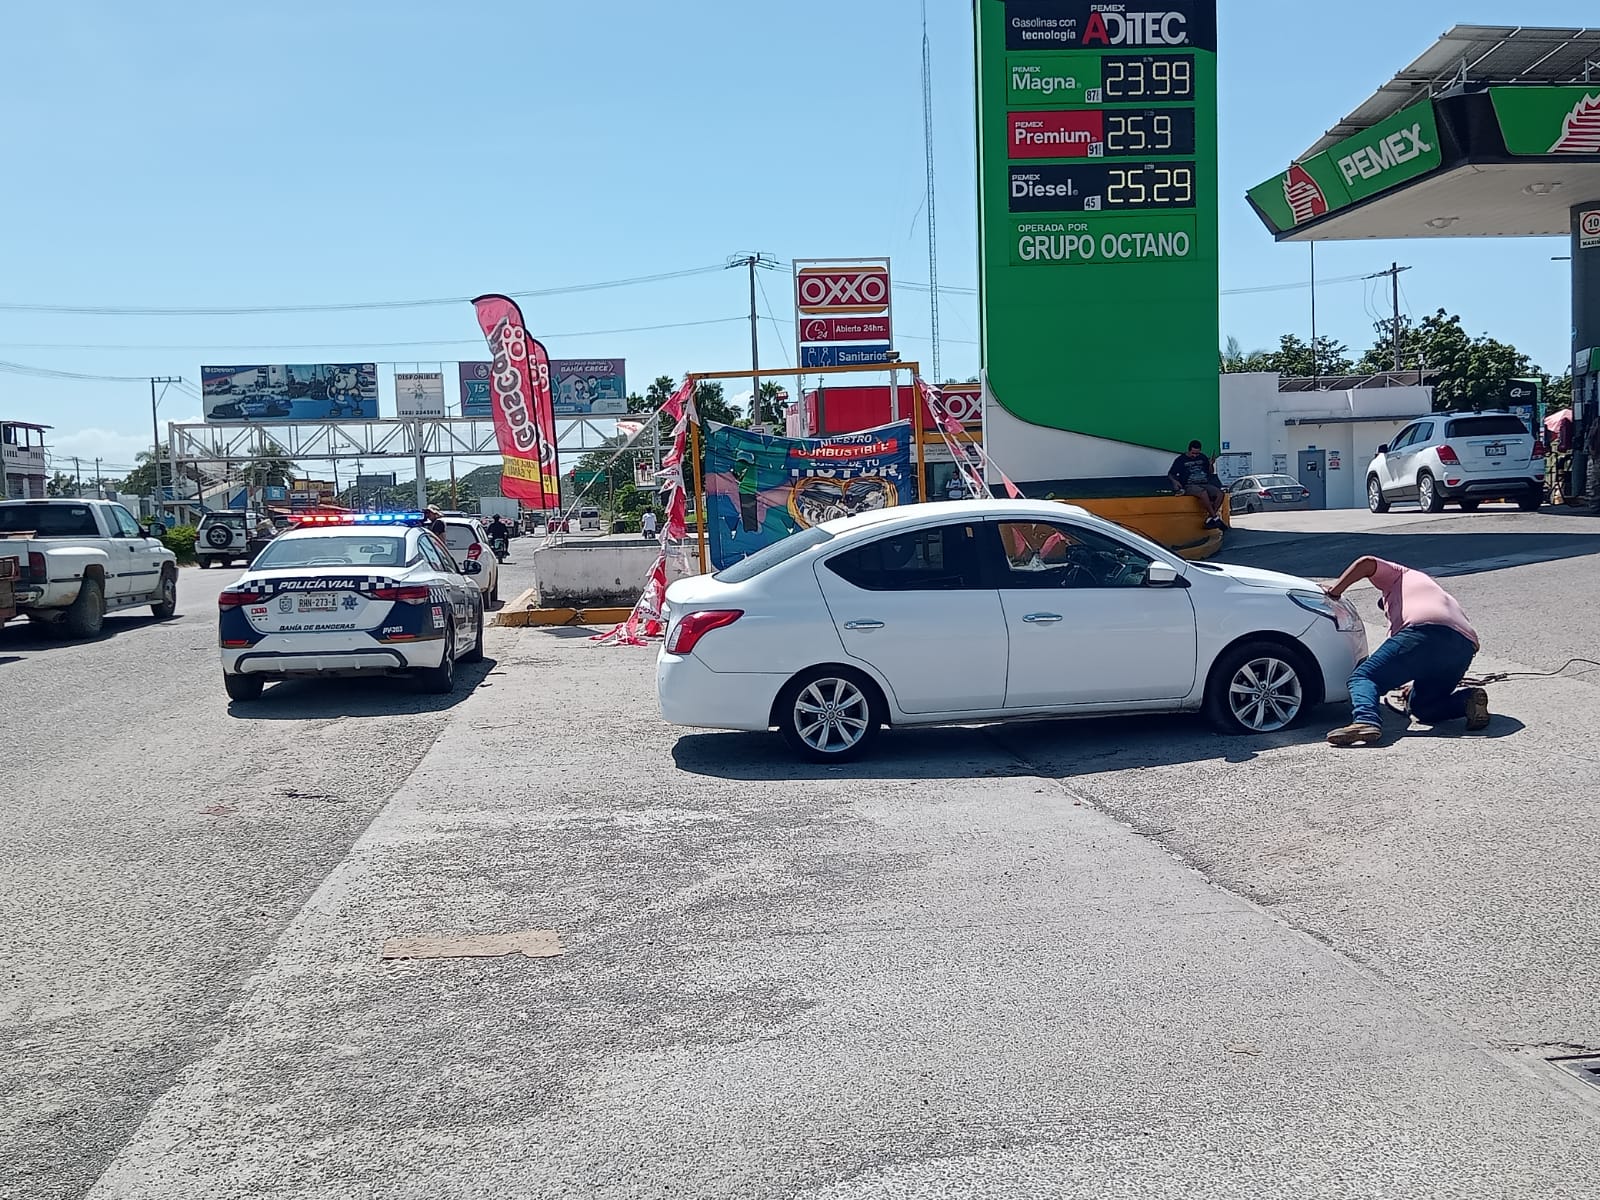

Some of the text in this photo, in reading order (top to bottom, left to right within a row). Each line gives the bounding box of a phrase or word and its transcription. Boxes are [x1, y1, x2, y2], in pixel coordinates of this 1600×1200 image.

[1091, 4, 1125, 12] PEMEX
[1012, 18, 1077, 28] Gasolinas con
[1022, 30, 1076, 42] tecnología
[1012, 73, 1076, 94] Magna
[1106, 61, 1190, 96] 23.99
[1086, 90, 1097, 102] 87
[1015, 121, 1043, 129] PEMEX
[1015, 127, 1091, 145] Premium
[1107, 115, 1171, 150] 25.9
[1338, 123, 1431, 186] PEMEX
[1011, 174, 1040, 182] PEMEX
[1011, 178, 1073, 198] Diesel
[1107, 168, 1191, 203] 25.29
[1085, 197, 1097, 209] 45
[1018, 223, 1088, 233] OPERADA POR
[1018, 231, 1190, 261] GRUPO OCTANO
[801, 273, 886, 306] OXXO
[836, 322, 887, 334] Abierto 24hrs.
[838, 350, 888, 363] Sanitarios
[396, 373, 440, 381] DISPONIBLE
[278, 578, 355, 591] POLICÍA VIAL
[298, 598, 336, 608] RHN-273-A
[279, 623, 302, 632] BAHÍA
[315, 623, 356, 631] BANDERAS
